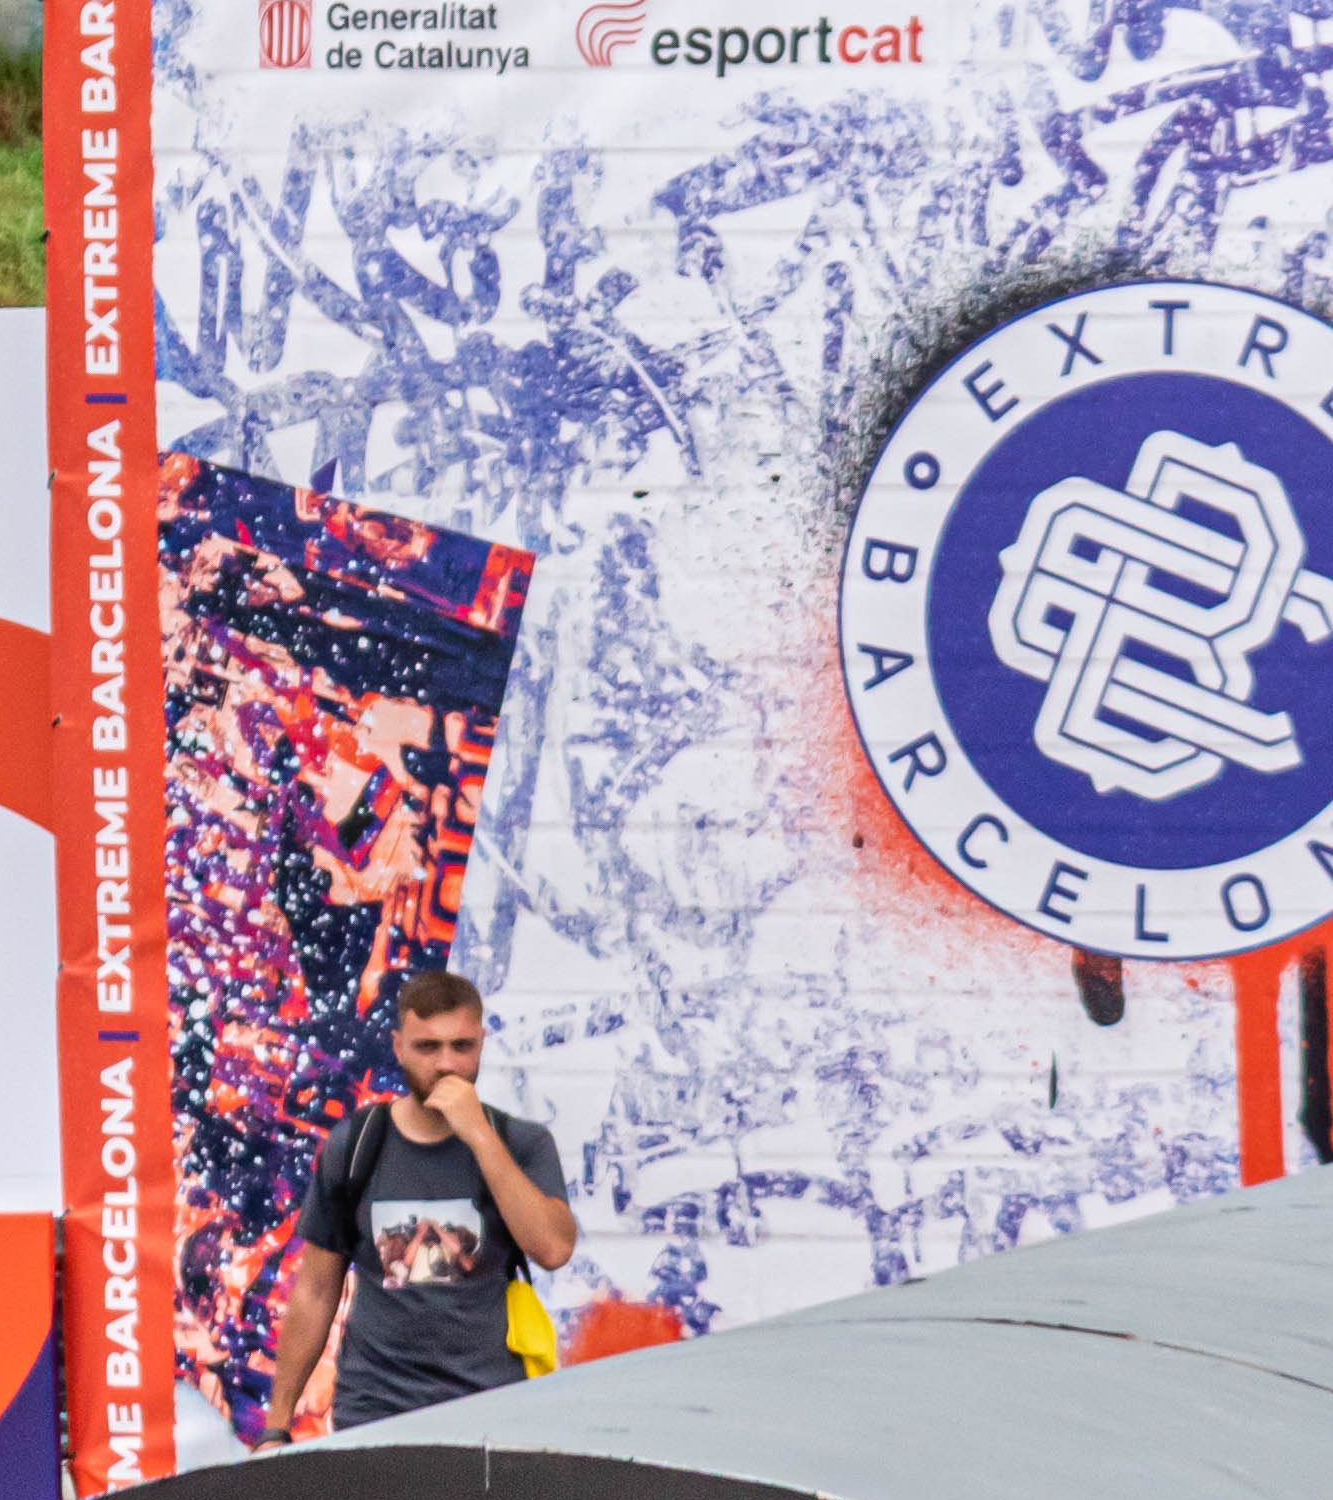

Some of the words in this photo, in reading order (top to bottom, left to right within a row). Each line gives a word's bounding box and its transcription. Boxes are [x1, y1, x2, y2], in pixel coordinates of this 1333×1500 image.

[326, 1, 498, 31] Generalitat
[326, 41, 362, 69] de
[373, 41, 530, 75] Catalunya
[650, 15, 923, 77] esportcat
[81, 127, 120, 376] EXTREME
[963, 299, 1333, 426] EXTR
[86, 419, 129, 753] BARCELONA
[93, 765, 131, 1014] EXTREME
[100, 1056, 143, 1390] BARCELONA
